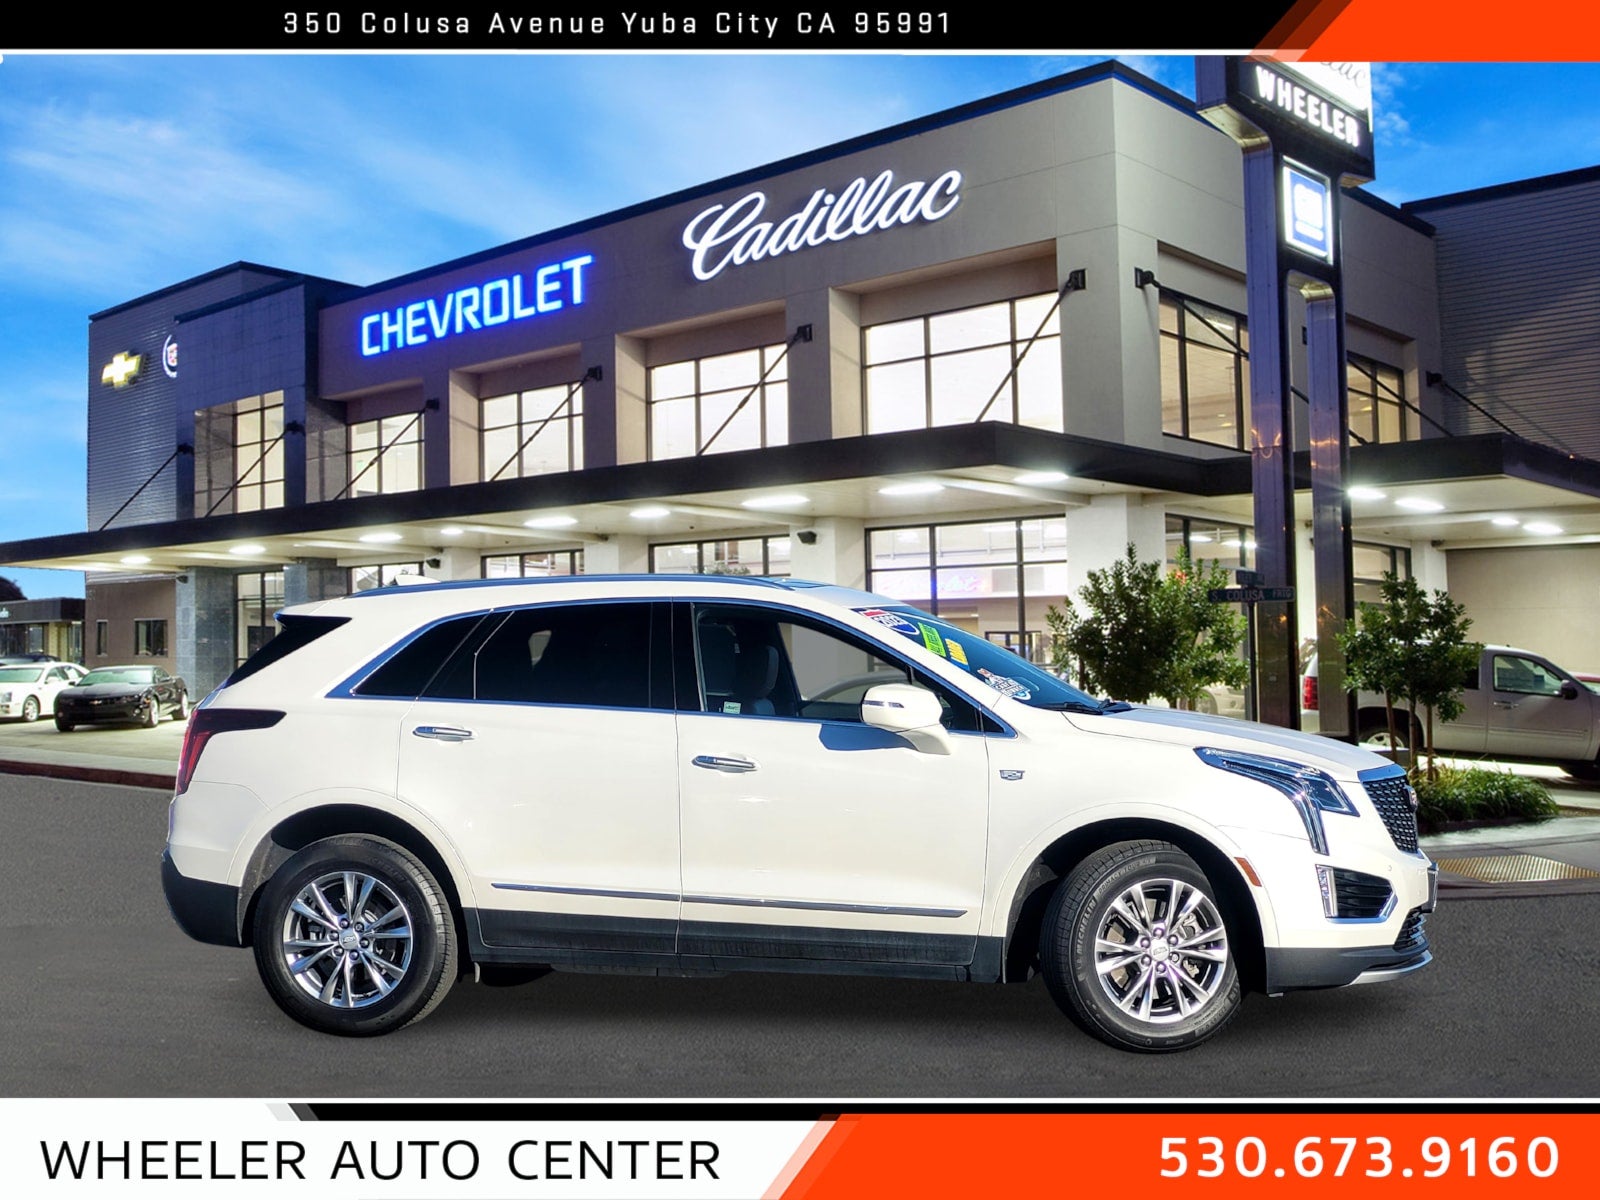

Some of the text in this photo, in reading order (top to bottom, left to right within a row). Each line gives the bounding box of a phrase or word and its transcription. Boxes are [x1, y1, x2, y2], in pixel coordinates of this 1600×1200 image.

[1255, 65, 1360, 148] WHEELER
[682, 169, 962, 282] Cadillac
[361, 254, 594, 357] CHEVROLET
[1226, 589, 1265, 602] COLUSA
